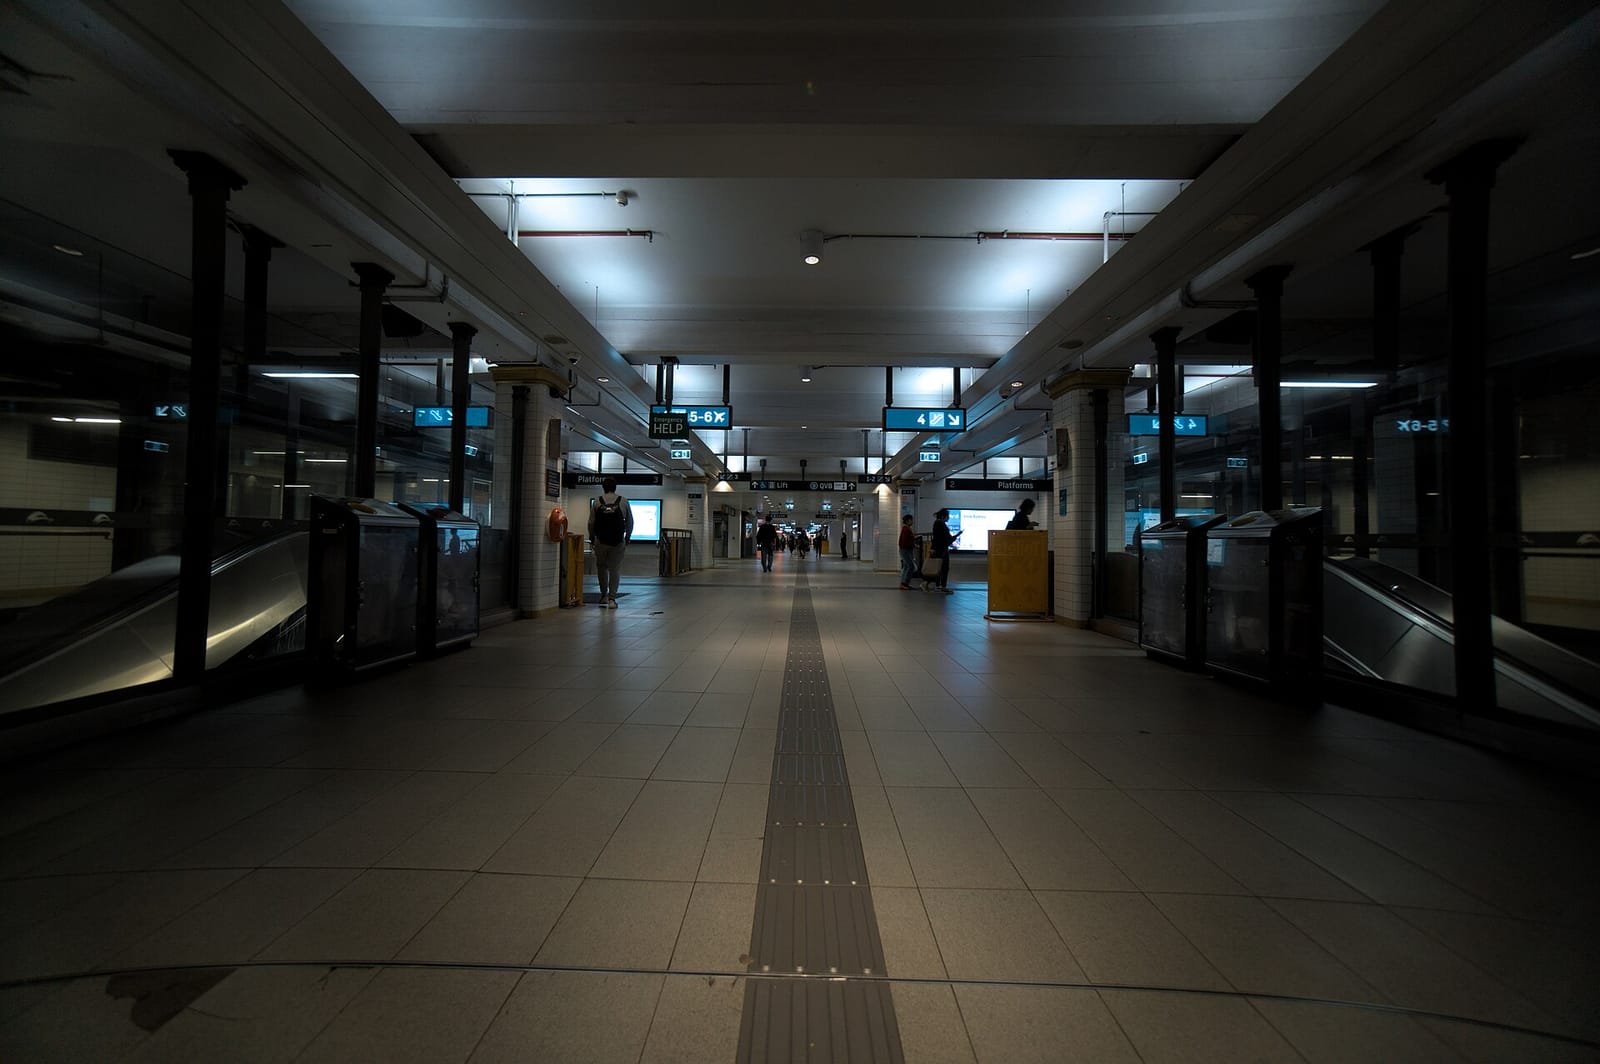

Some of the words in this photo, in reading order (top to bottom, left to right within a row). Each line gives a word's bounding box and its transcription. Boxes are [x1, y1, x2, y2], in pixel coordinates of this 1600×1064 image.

[653, 416, 684, 424] Emergency
[690, 410, 713, 423] 5-6
[916, 413, 926, 425] 4
[653, 423, 683, 434] HELP
[577, 475, 606, 484] Platfor
[776, 480, 788, 489] Lift
[819, 482, 833, 490] QVB
[997, 480, 1034, 490] Platforms
